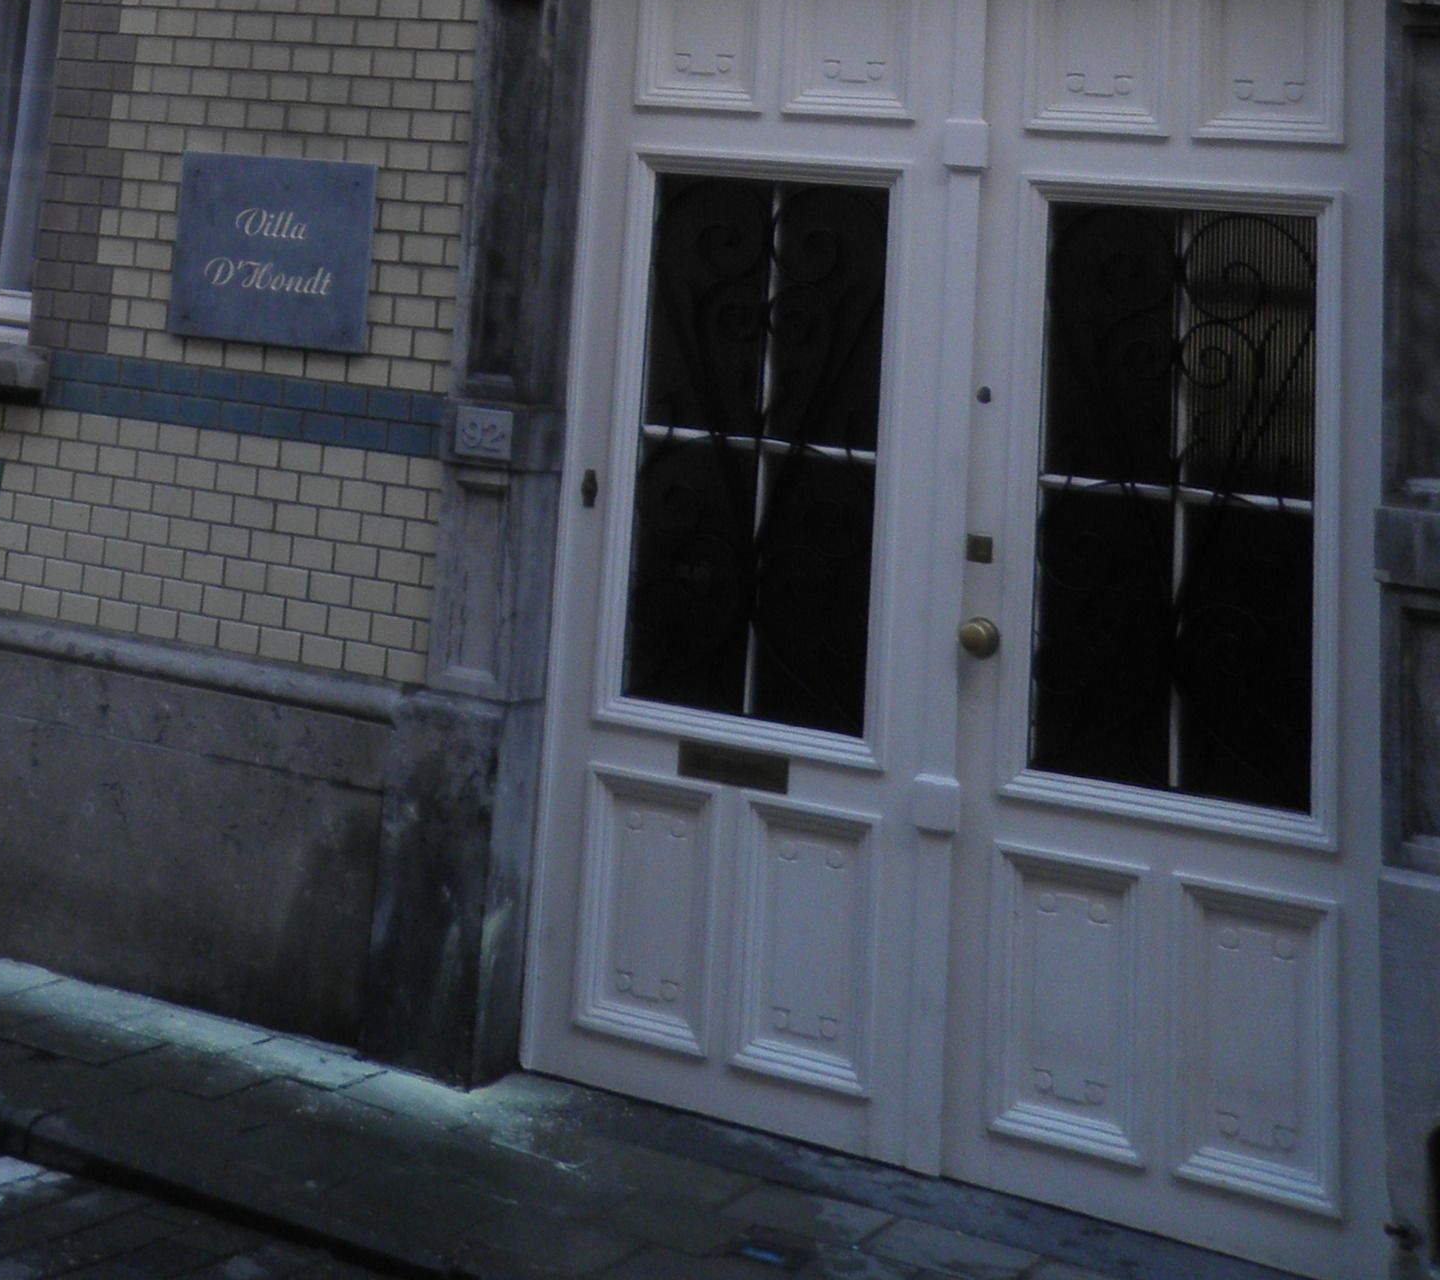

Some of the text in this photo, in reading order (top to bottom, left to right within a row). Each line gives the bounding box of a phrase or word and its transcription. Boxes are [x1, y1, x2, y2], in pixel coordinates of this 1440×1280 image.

[235, 207, 307, 240] Villa
[203, 256, 332, 296] D'Hondt
[462, 421, 506, 453] 92
